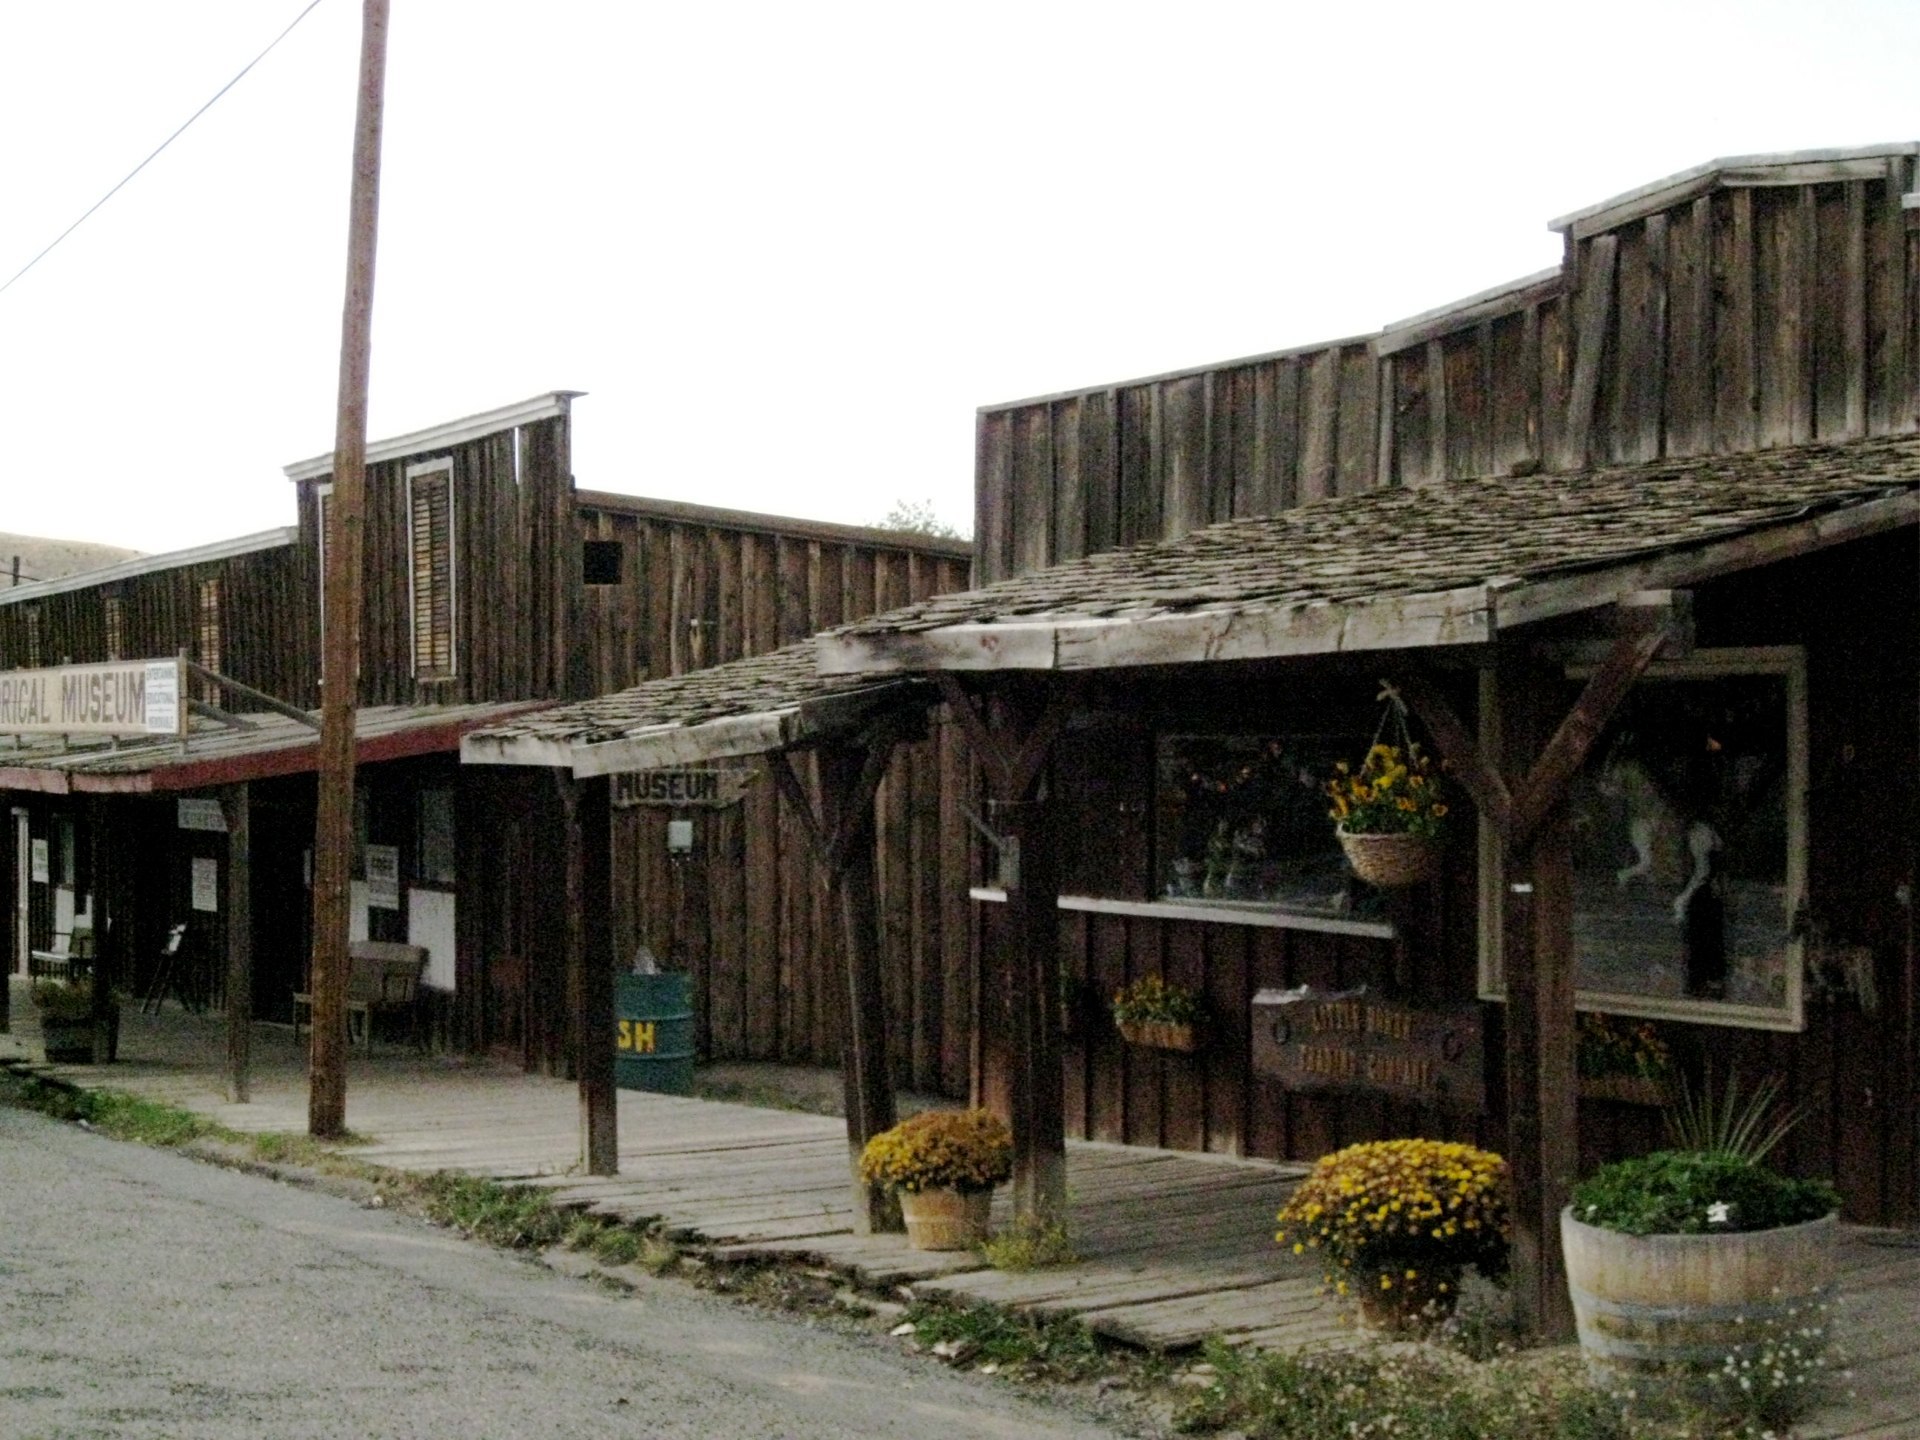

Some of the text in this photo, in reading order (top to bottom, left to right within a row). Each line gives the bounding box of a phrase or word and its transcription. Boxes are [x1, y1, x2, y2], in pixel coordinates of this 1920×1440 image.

[1, 670, 146, 725] RICAL MUSEUM
[616, 770, 719, 801] MUSEUM
